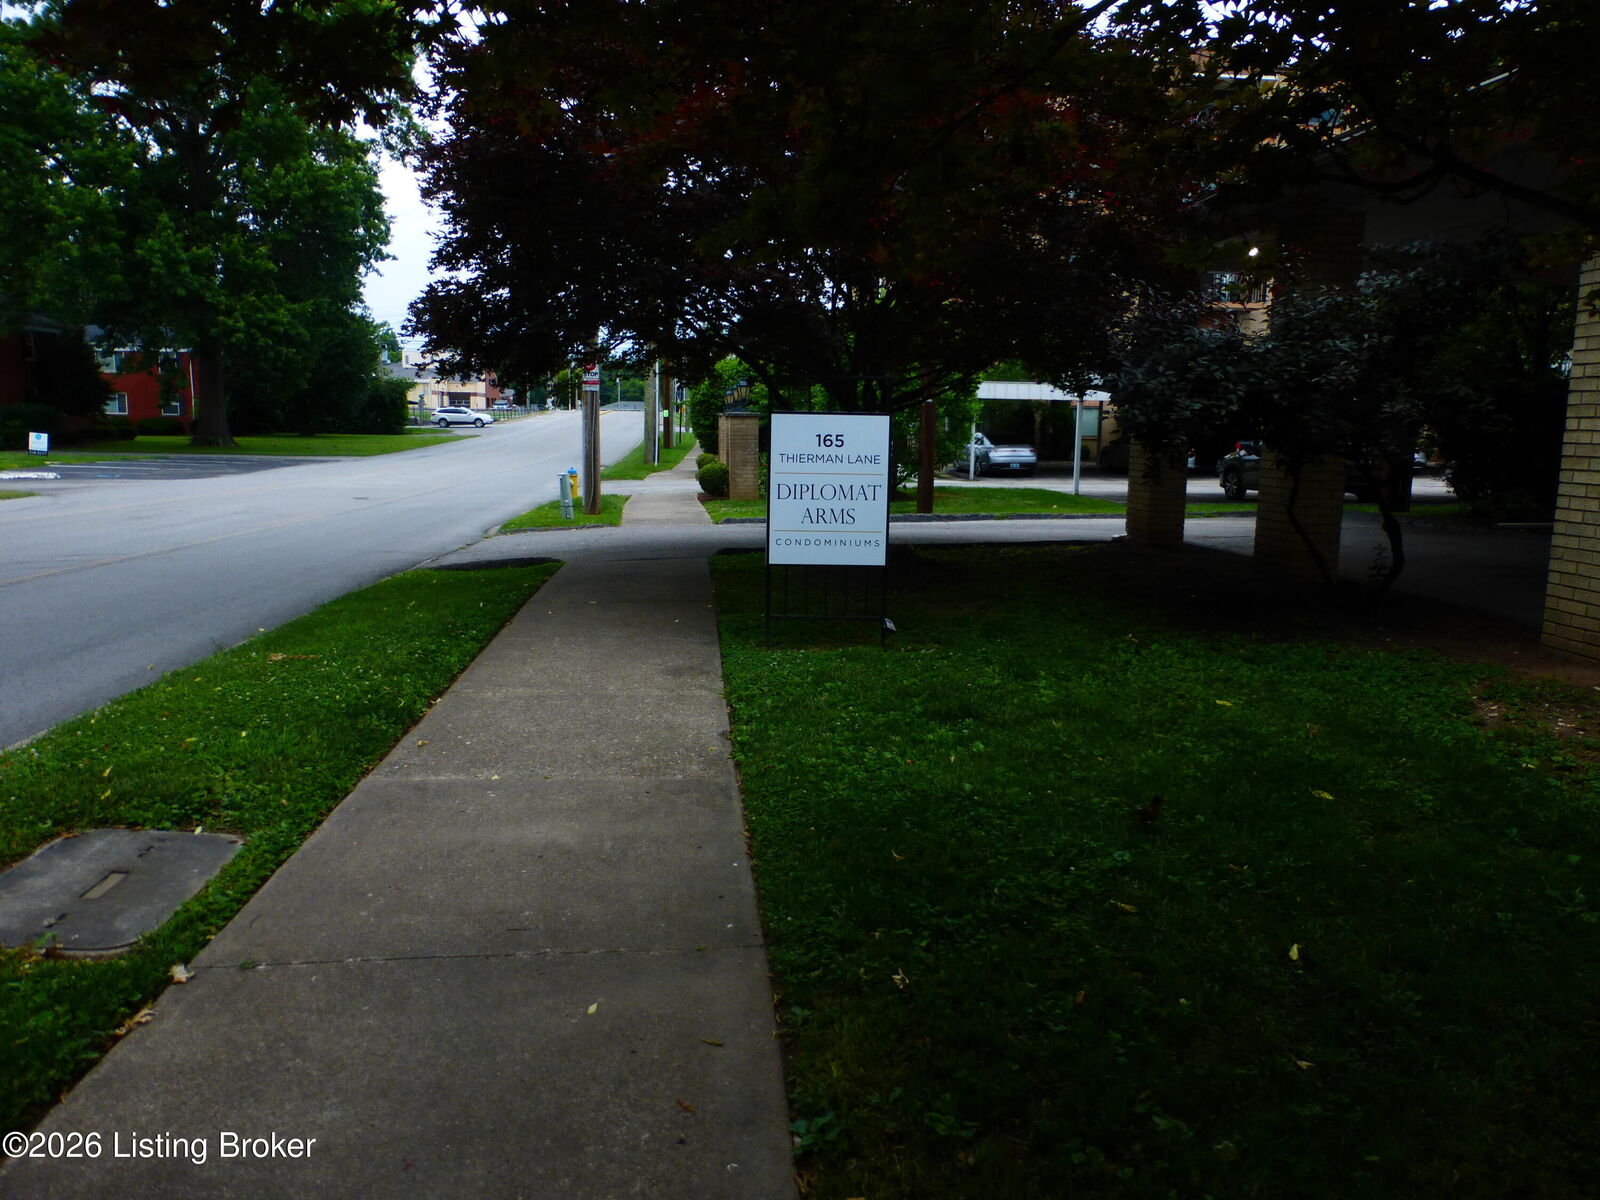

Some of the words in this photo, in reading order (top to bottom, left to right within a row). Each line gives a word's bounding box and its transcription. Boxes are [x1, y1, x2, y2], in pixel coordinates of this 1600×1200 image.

[816, 434, 844, 447] 165
[779, 453, 843, 464] THIERMAN
[847, 454, 881, 465] LANE
[777, 483, 882, 501] DIPLOMAT
[801, 507, 856, 525] ARMS
[775, 538, 880, 547] CONDOMINIUMS
